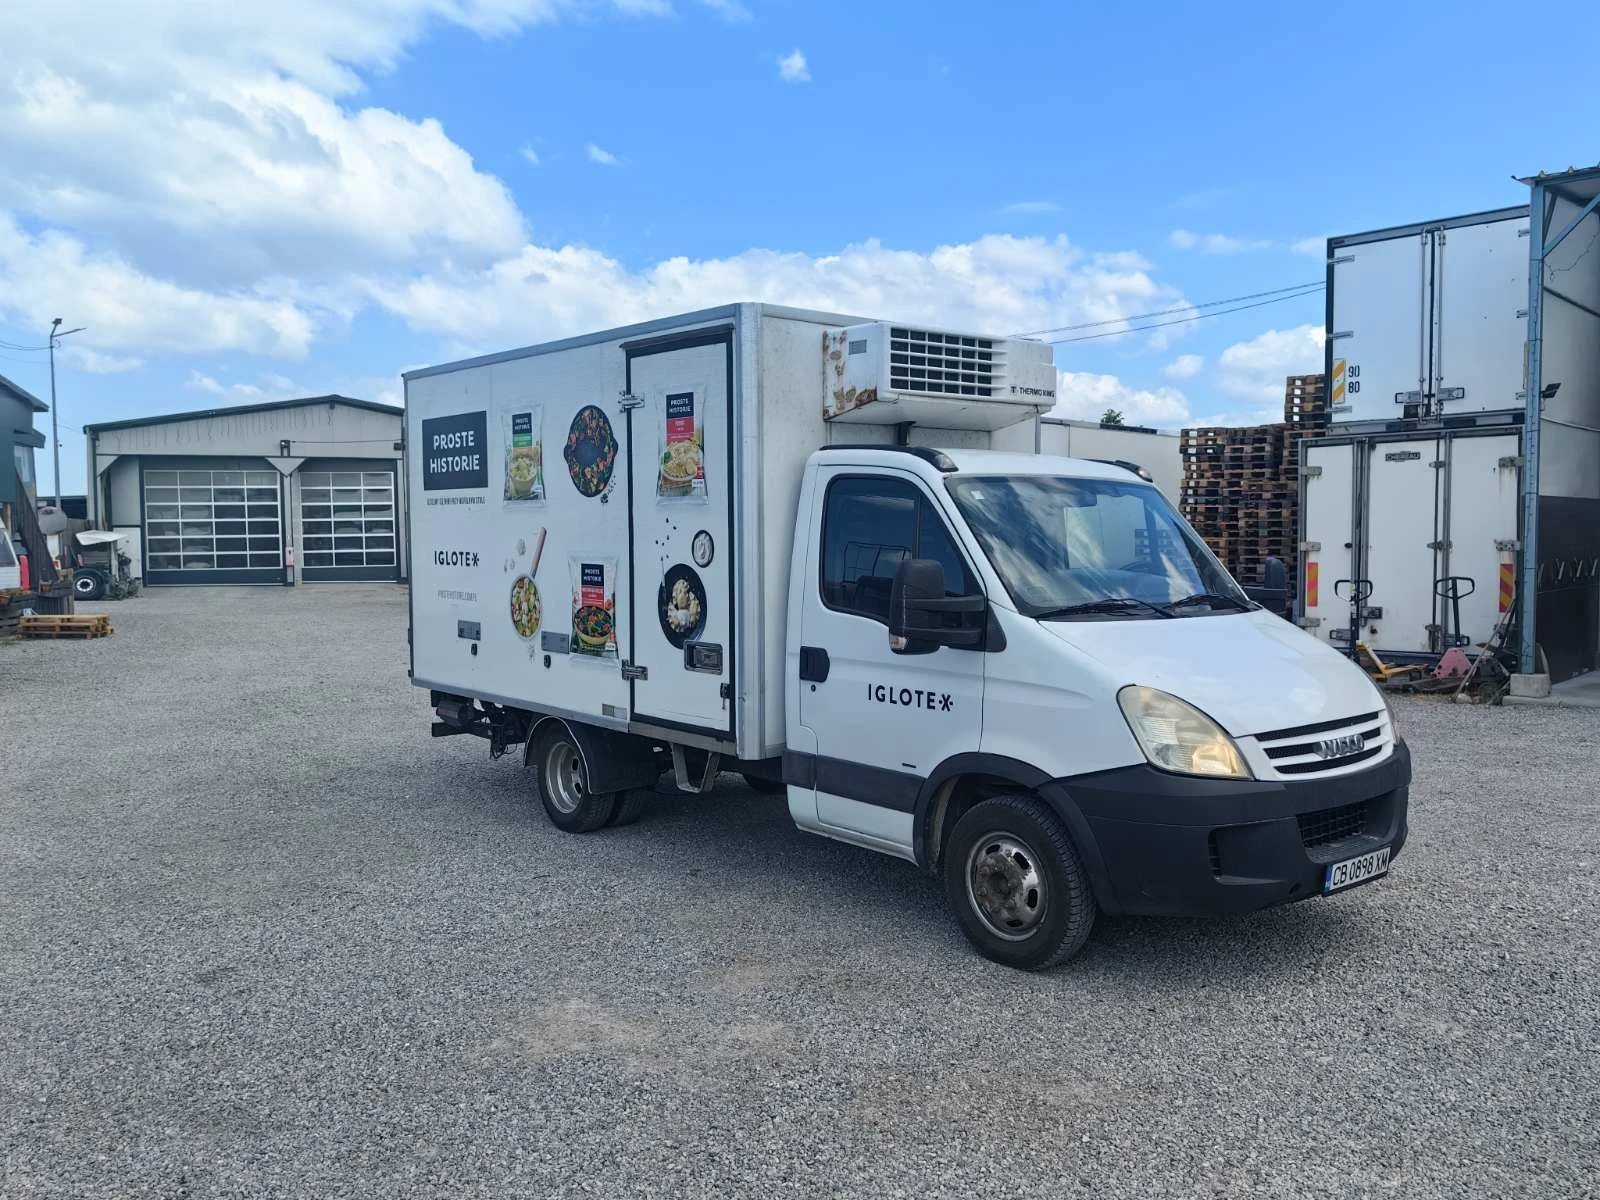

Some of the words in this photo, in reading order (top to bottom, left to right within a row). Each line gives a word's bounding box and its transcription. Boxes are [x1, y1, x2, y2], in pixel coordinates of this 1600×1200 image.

[1348, 365, 1360, 378] 90
[433, 430, 475, 450] PROSTE
[430, 454, 480, 474] HISTORIE
[434, 550, 480, 567] IGLOTEX
[868, 683, 954, 712] IGLOTEX
[1333, 864, 1348, 886] CB
[1349, 856, 1374, 881] 0898
[1374, 850, 1389, 873] XM
